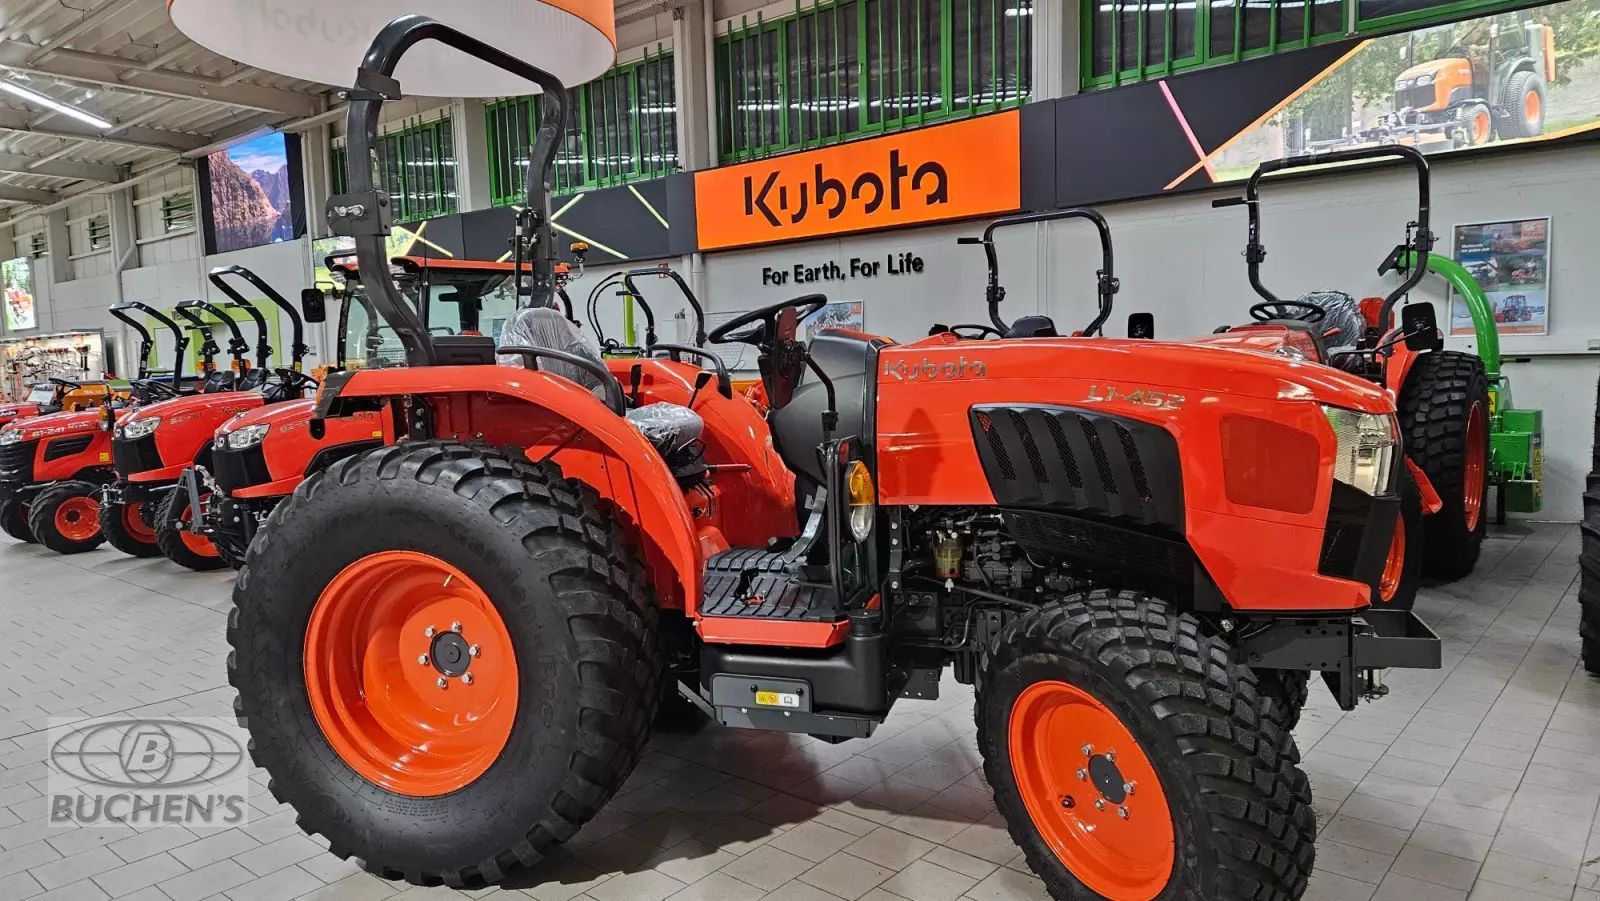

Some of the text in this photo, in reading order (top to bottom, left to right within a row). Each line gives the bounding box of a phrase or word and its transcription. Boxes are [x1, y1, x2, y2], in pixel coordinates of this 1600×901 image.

[744, 149, 948, 227] Kubota
[762, 252, 924, 285] For Earth, For Life
[884, 356, 987, 381] Kubota
[1088, 384, 1186, 411] L1-452
